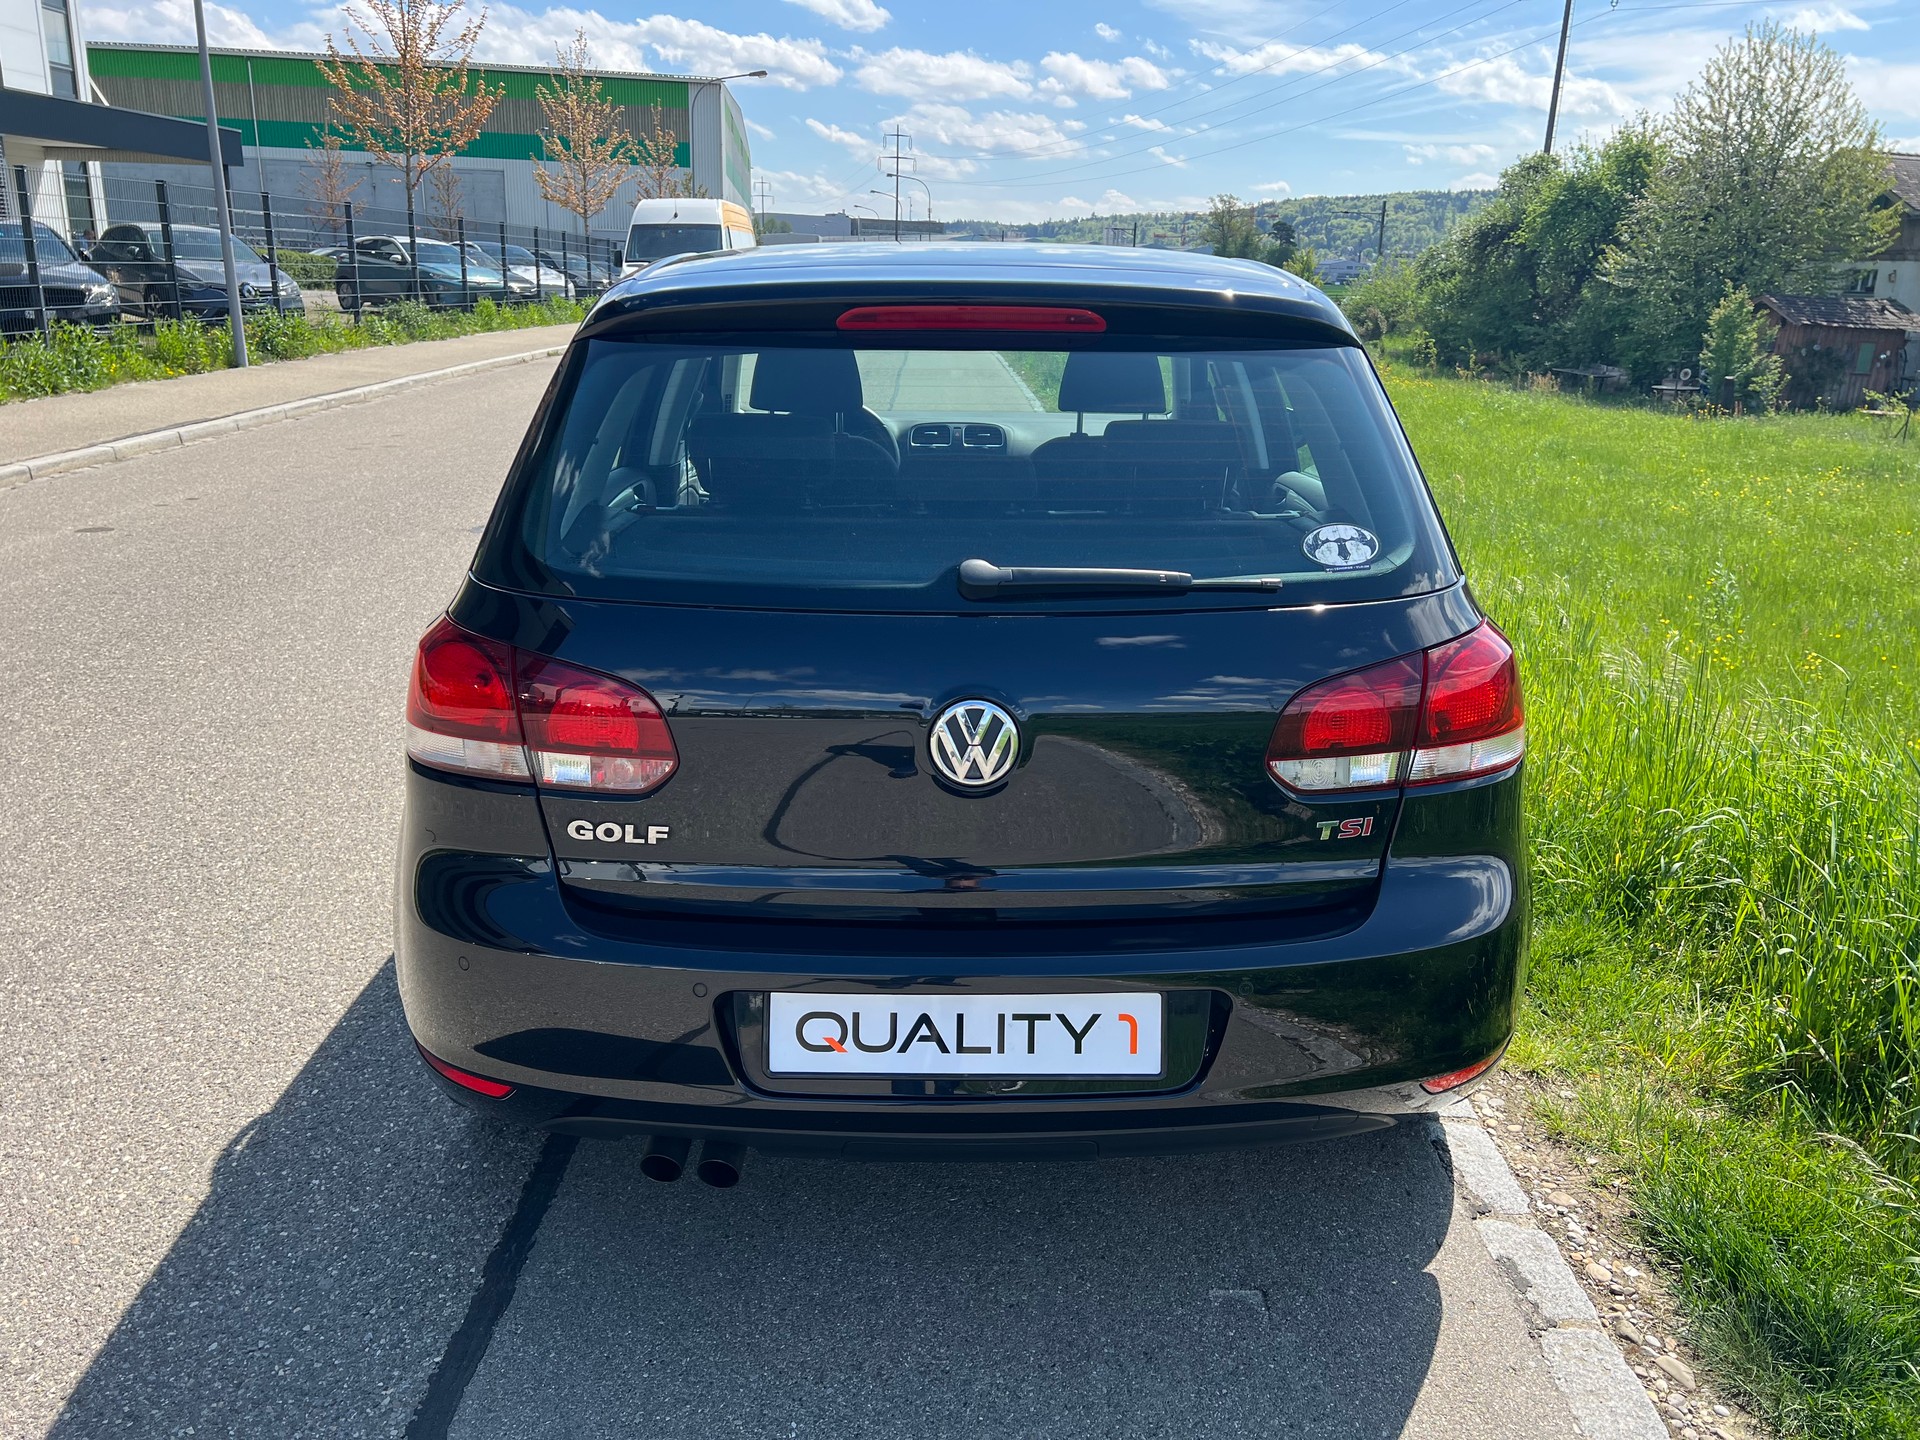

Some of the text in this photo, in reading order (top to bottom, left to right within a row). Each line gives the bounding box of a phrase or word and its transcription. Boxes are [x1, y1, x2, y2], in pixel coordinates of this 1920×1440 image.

[935, 702, 1014, 783] VW
[567, 820, 669, 844] GOLF
[1316, 816, 1374, 840] TSI
[795, 1011, 1138, 1055] QUALITY 1
